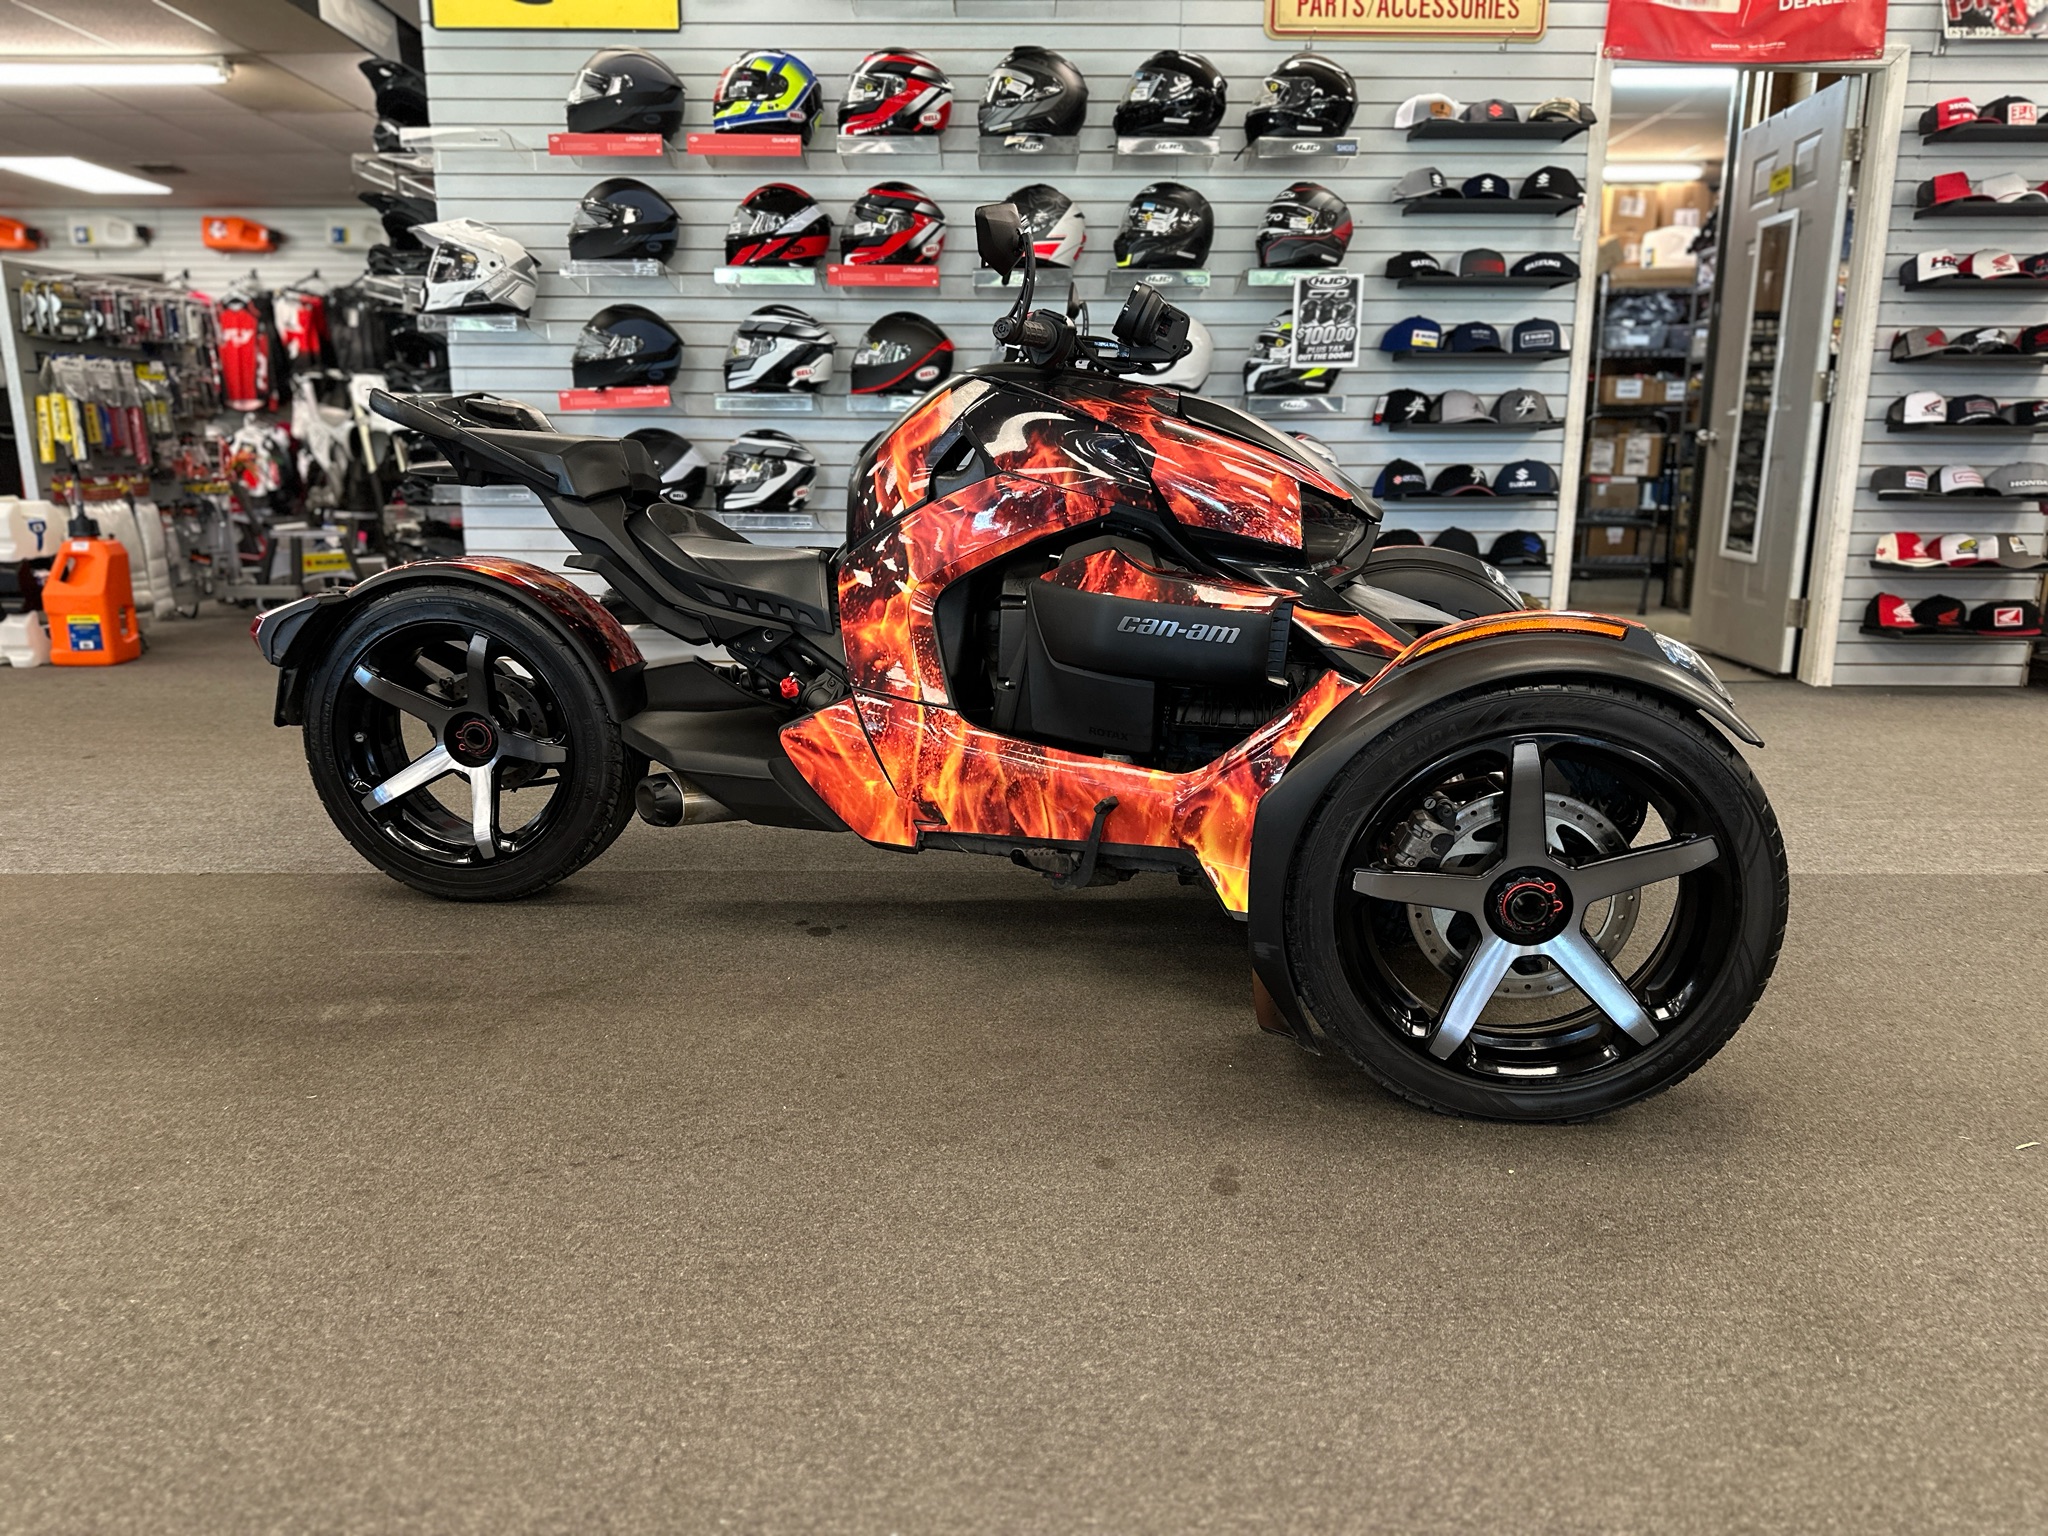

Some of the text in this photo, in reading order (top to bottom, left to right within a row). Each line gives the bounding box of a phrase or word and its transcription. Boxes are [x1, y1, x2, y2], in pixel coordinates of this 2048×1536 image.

[1296, 0, 1520, 19] PARTS/ACCESSORIES
[1314, 277, 1346, 285] HJC
[1307, 289, 1350, 298] C70
[1296, 325, 1356, 345] $100.00
[1306, 345, 1345, 354] PLUS TAX
[1508, 480, 1537, 488] SUZUKI
[1117, 615, 1241, 644] can-am
[1088, 726, 1129, 741] ROTAX
